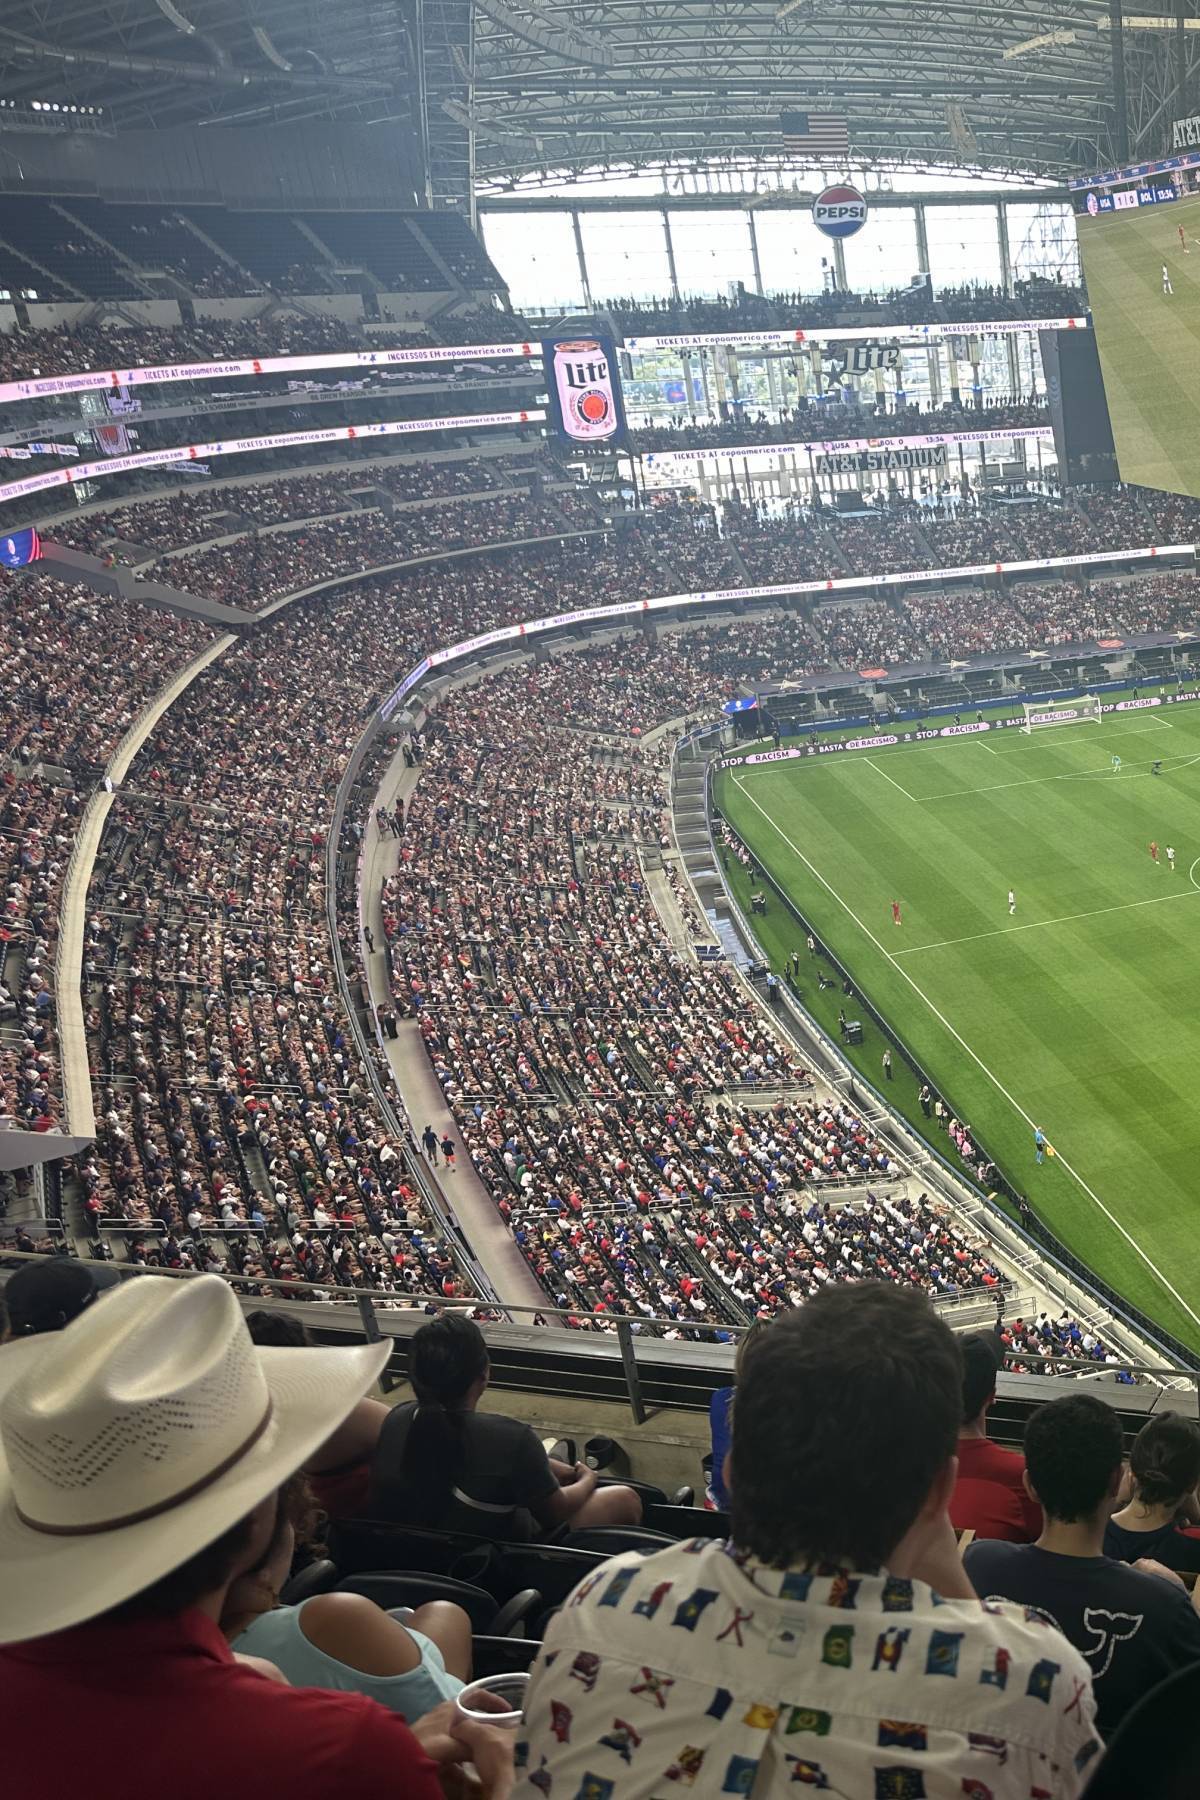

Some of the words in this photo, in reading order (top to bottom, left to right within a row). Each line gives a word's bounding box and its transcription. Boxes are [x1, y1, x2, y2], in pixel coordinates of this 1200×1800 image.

[1100, 197, 1111, 208] USA
[1140, 191, 1152, 202] BOL
[817, 206, 864, 218] PEPSI
[940, 325, 979, 333] INGRESSOS
[656, 337, 691, 346] TICKETS
[692, 336, 702, 344] AT
[388, 351, 428, 361] INGRESSOS
[429, 350, 441, 358] EM
[840, 344, 899, 375] Lite
[144, 368, 170, 380] TICKETS
[171, 368, 179, 377] AT
[564, 362, 607, 389] Lite
[396, 422, 433, 431] INGRESSOS
[990, 431, 1001, 439] EM
[236, 439, 263, 449] TICKETS
[264, 438, 273, 446] EN
[834, 441, 850, 449] USA
[880, 438, 894, 446] BOL
[673, 451, 706, 461] TICKETS
[708, 450, 718, 458] AT
[95, 461, 122, 473] INGRESSOS
[122, 460, 131, 469] EM
[818, 454, 864, 475] AT&T
[867, 448, 946, 471] STADIUM
[721, 757, 743, 768] STOP
[755, 751, 789, 762] RACISM
[819, 744, 843, 753] BASTA
[850, 740, 859, 748] DE
[861, 736, 895, 747] RACISMO
[916, 730, 938, 740] STOP
[949, 724, 979, 734] RACISM
[1094, 704, 1114, 713] STOP
[1124, 699, 1152, 708] RACISM
[1176, 693, 1196, 701] BASTA
